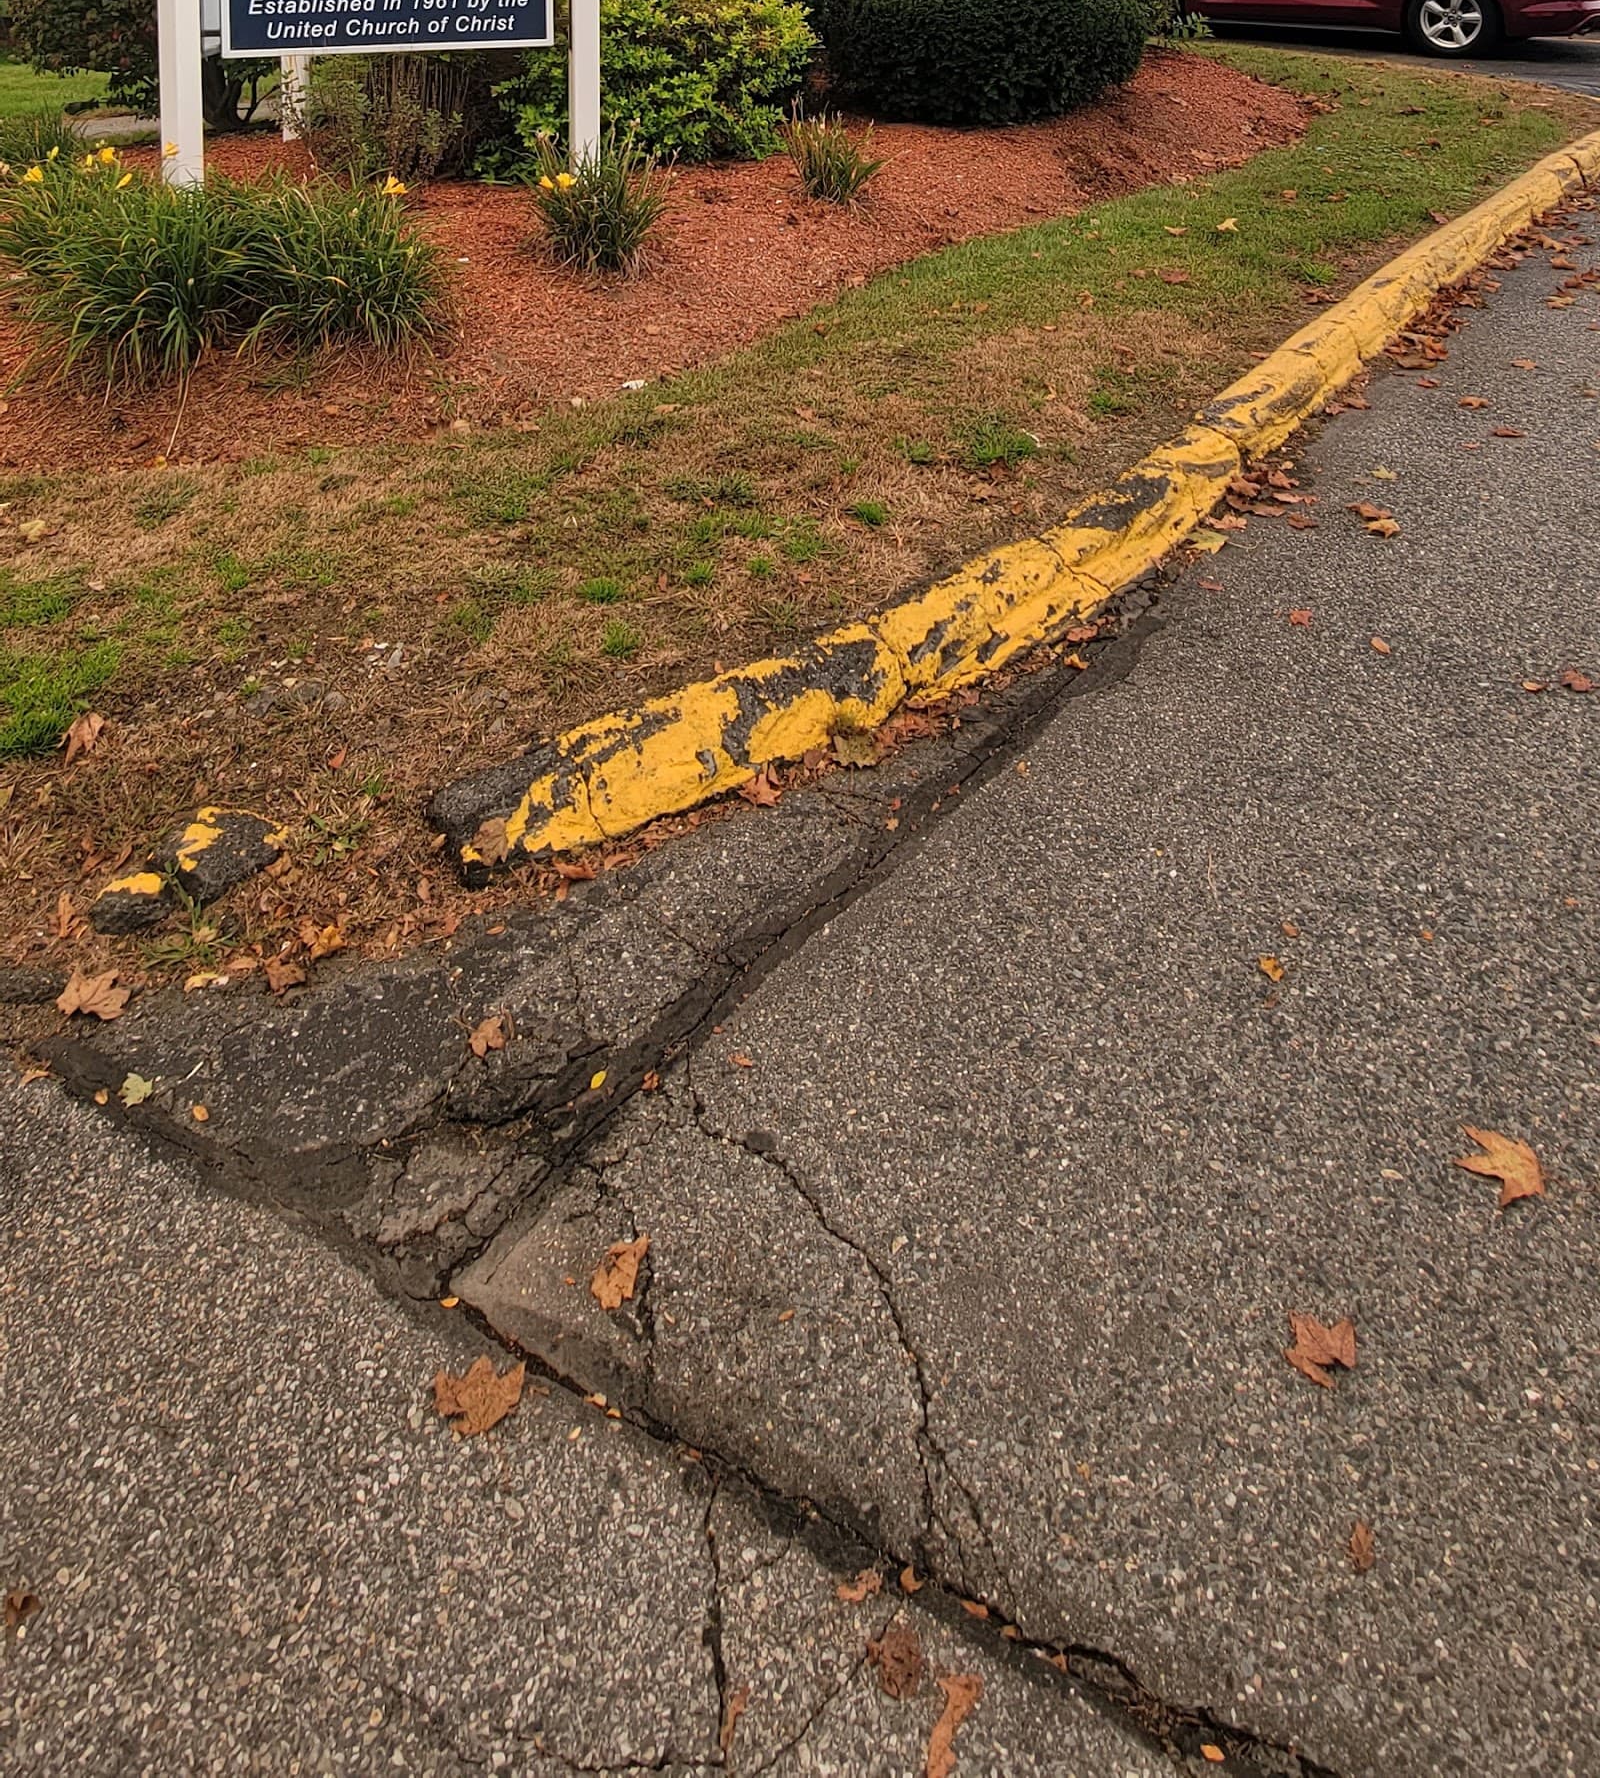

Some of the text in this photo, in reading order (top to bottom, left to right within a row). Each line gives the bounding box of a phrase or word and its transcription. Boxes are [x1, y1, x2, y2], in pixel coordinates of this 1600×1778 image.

[266, 15, 515, 39] United Church of Christ
